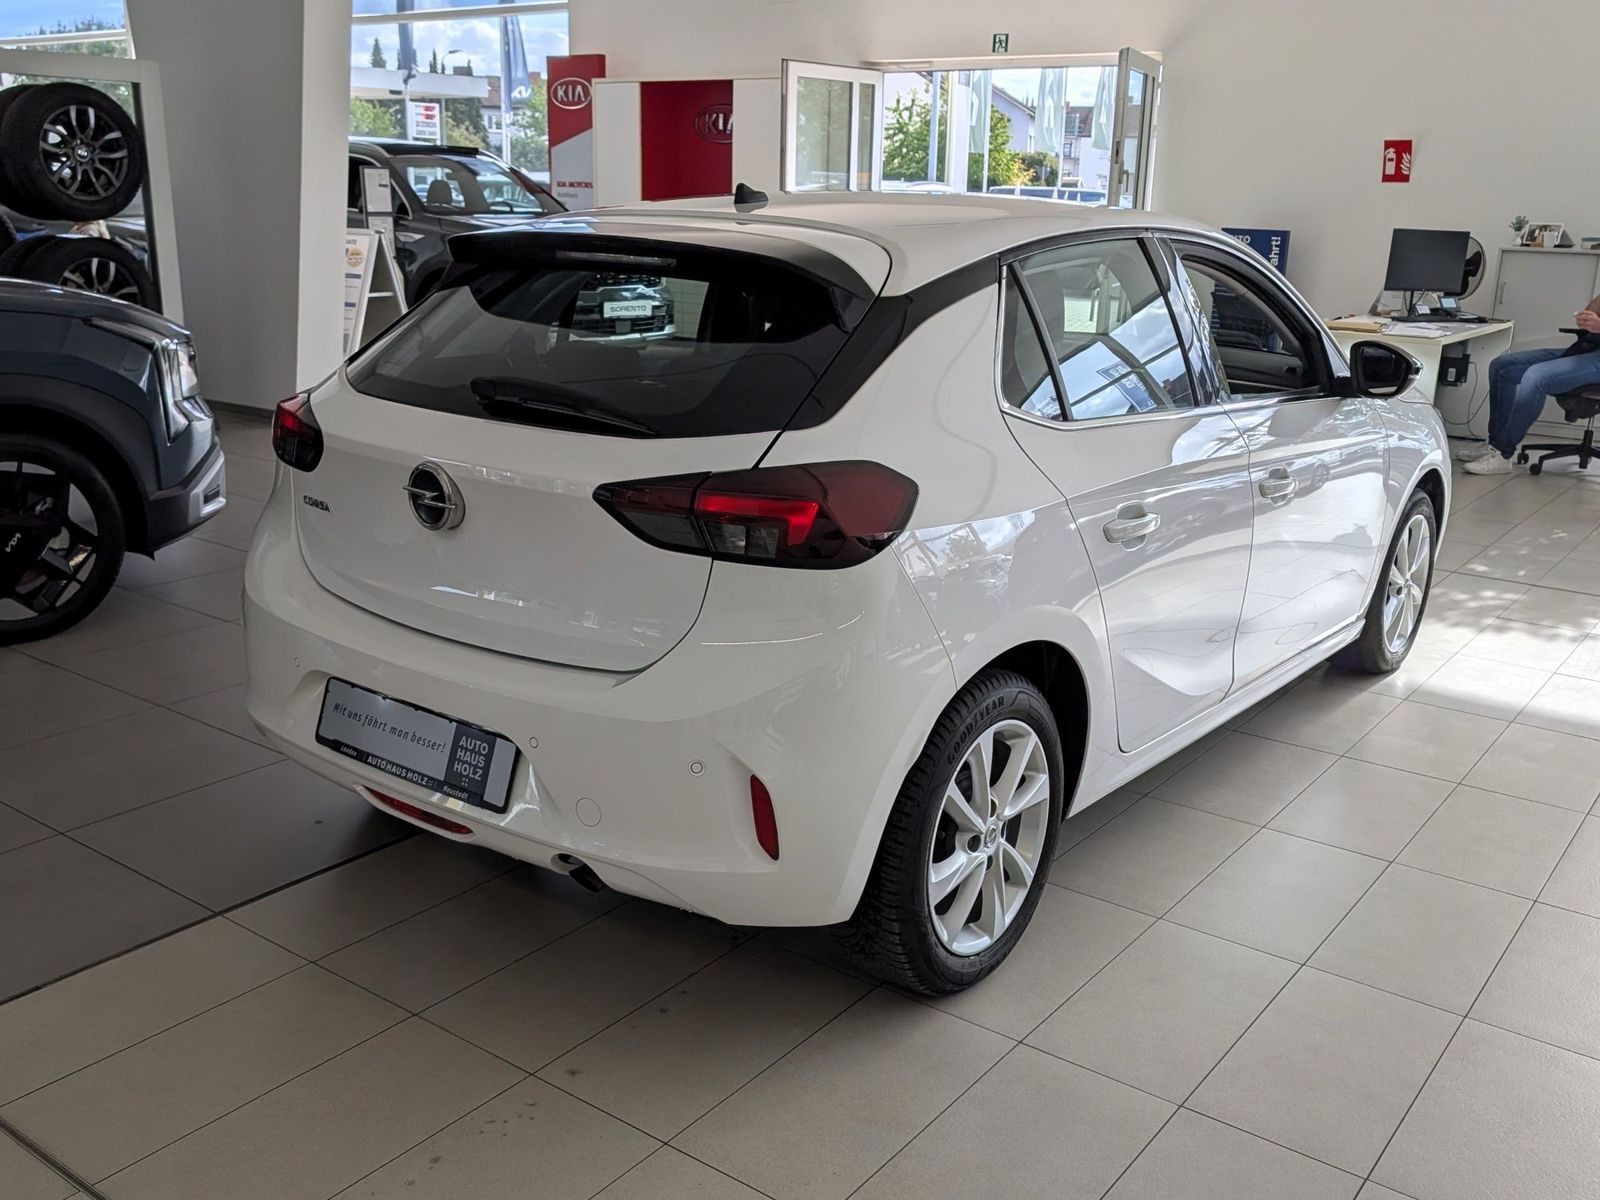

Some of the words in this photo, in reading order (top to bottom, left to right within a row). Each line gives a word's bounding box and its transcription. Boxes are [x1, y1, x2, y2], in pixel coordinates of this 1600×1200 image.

[556, 84, 586, 102] KIA
[1269, 236, 1281, 267] ahrt!
[610, 305, 647, 313] SORENTO
[303, 494, 331, 513] CORSA
[333, 702, 347, 717] Mit
[347, 710, 362, 722] uns
[361, 713, 388, 732] fährt
[388, 725, 409, 740] man
[411, 731, 447, 754] besser!
[947, 696, 1005, 765] GOODYEAR
[459, 736, 489, 755] AUTO
[456, 748, 486, 768] HAUS
[407, 771, 428, 786] HOLZ
[453, 761, 484, 781] HOLZ
[443, 785, 469, 800] Neustadt
